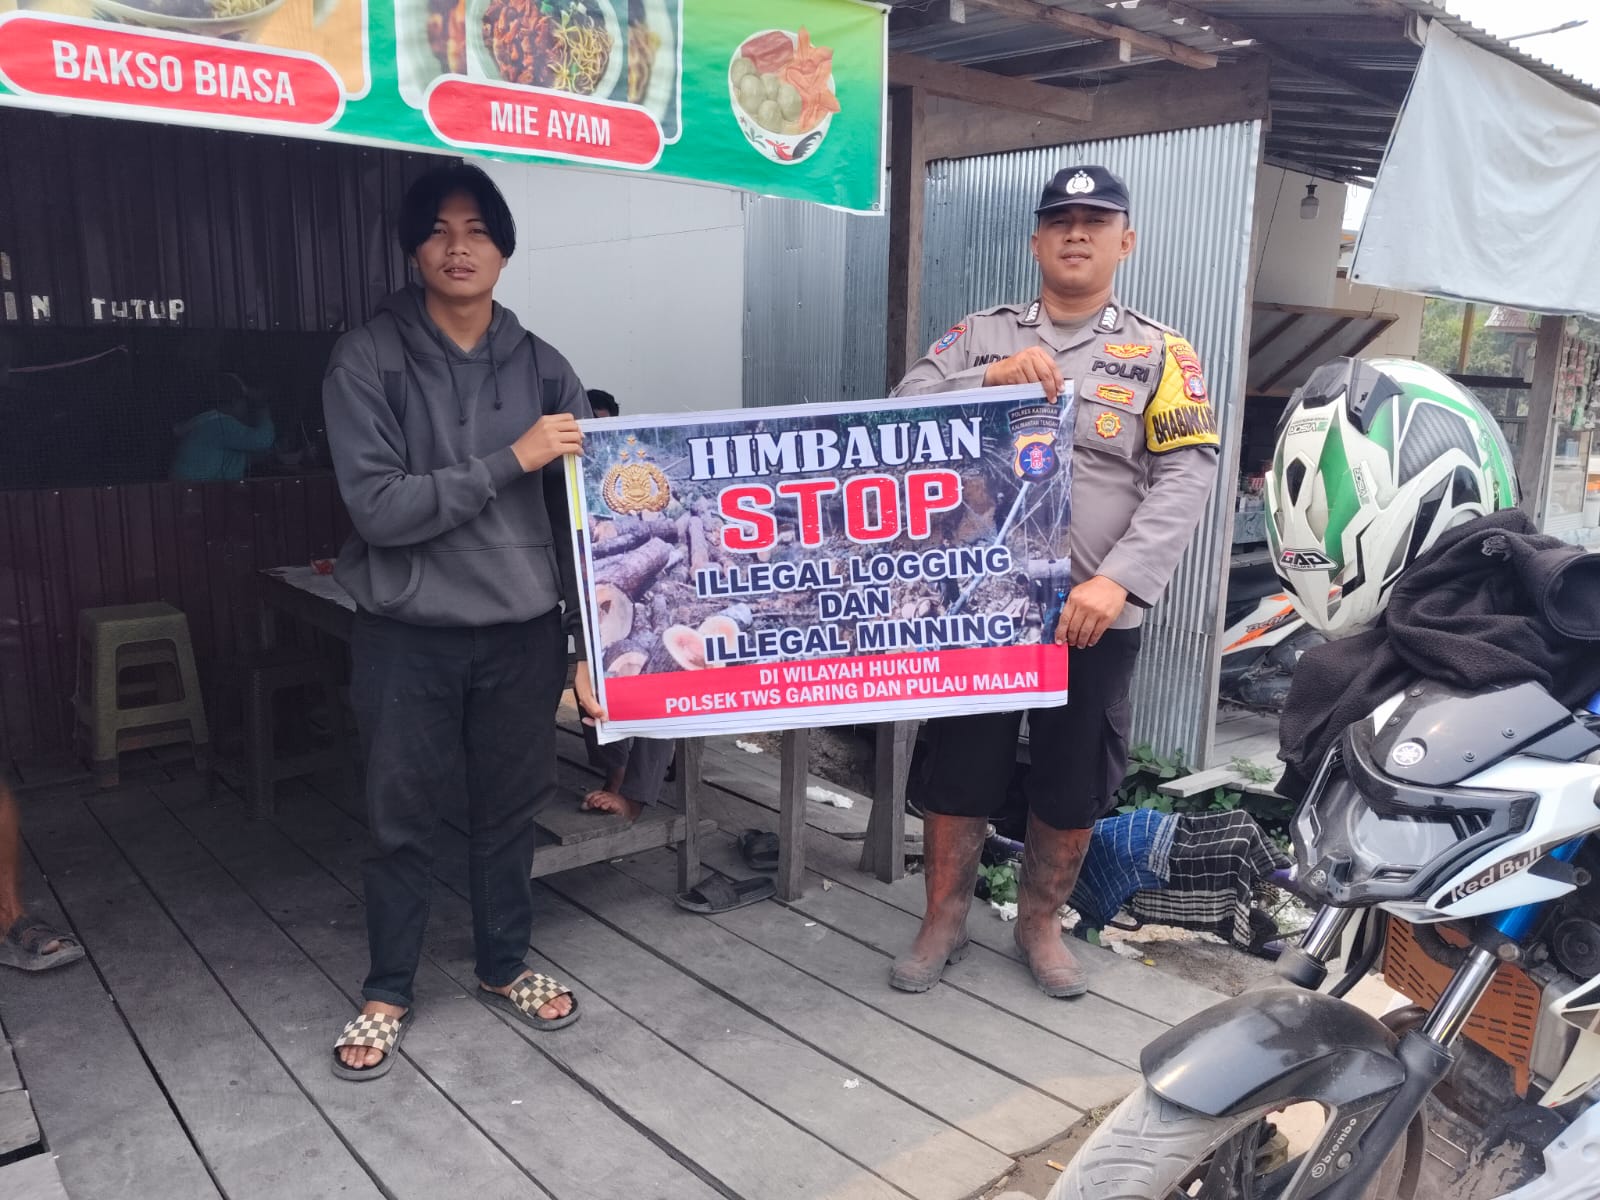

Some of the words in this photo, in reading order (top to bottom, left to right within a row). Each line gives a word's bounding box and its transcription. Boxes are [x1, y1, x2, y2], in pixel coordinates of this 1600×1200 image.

[52, 39, 183, 93] BAKSO
[195, 63, 296, 107] BIASA
[490, 101, 539, 138] MIE
[546, 110, 611, 147] AYAM
[91, 298, 185, 321] TUTUP
[1091, 360, 1150, 383] POLRI
[1011, 409, 1031, 420] POLRES
[688, 417, 982, 482] HIMBAUAN
[718, 468, 963, 553] STOP
[697, 559, 842, 598] ILLEGAL
[852, 547, 1012, 586] LOGGING
[821, 588, 891, 622] DAN
[705, 624, 852, 663] ILLEGAL
[858, 615, 1015, 651] MINNING
[665, 692, 737, 713] POLSEK
[740, 688, 781, 709] TWS
[786, 682, 859, 705] GARING
[863, 679, 901, 697] DAN
[906, 675, 970, 695] PULAU
[972, 671, 1038, 691] MALAN
[760, 668, 779, 686] DI
[782, 661, 865, 685] WILAYAH
[869, 657, 940, 677] HUKUM
[1451, 867, 1495, 903] Red
[1500, 846, 1541, 877] Bull
[1321, 1118, 1357, 1164] brembo
